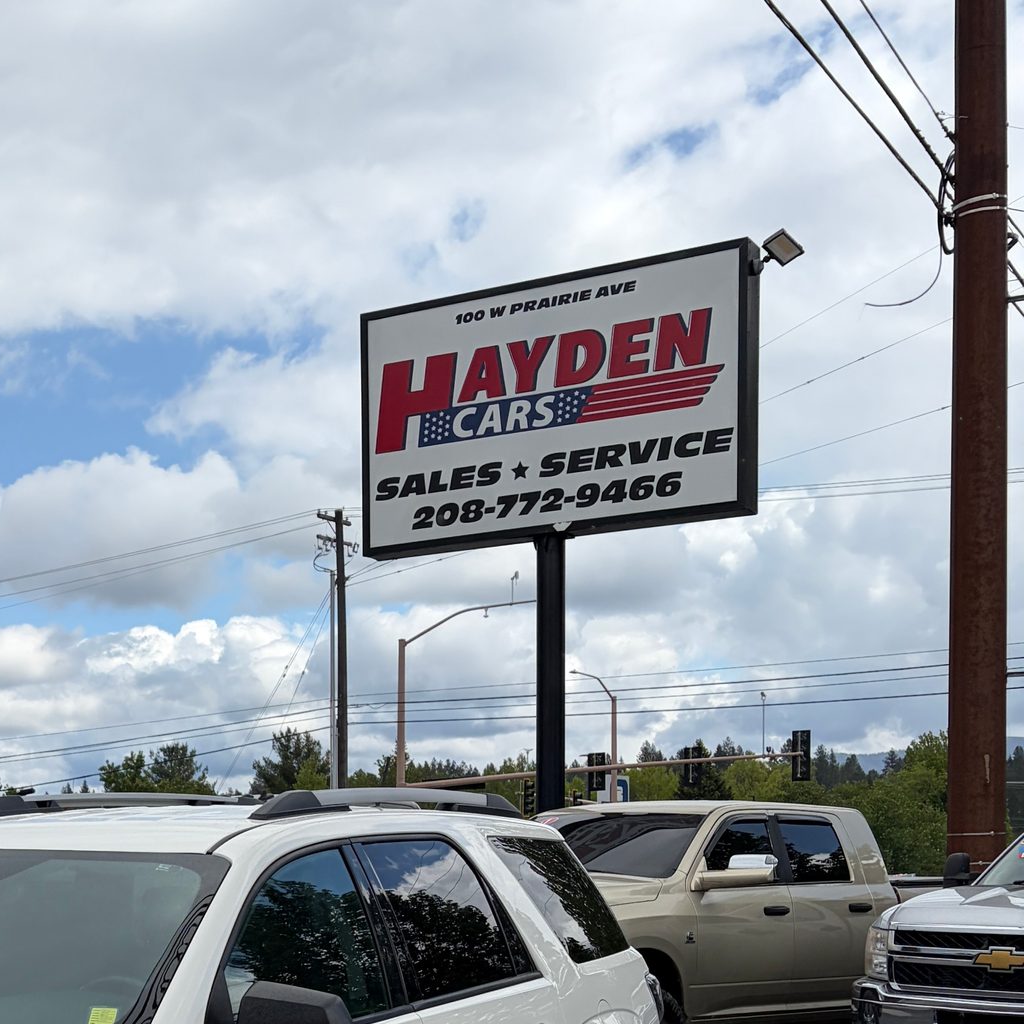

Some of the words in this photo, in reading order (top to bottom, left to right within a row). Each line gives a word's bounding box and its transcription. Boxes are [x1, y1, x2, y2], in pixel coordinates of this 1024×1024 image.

[455, 309, 485, 325] 100
[489, 305, 507, 319] W
[509, 289, 593, 315] PRAIRIE
[595, 280, 637, 299] AVE
[375, 307, 713, 454] HAYDEN
[451, 394, 556, 440] CARS
[376, 461, 504, 501] SALES
[538, 427, 735, 477] SERVICE
[411, 471, 683, 530] 208-772-9466
